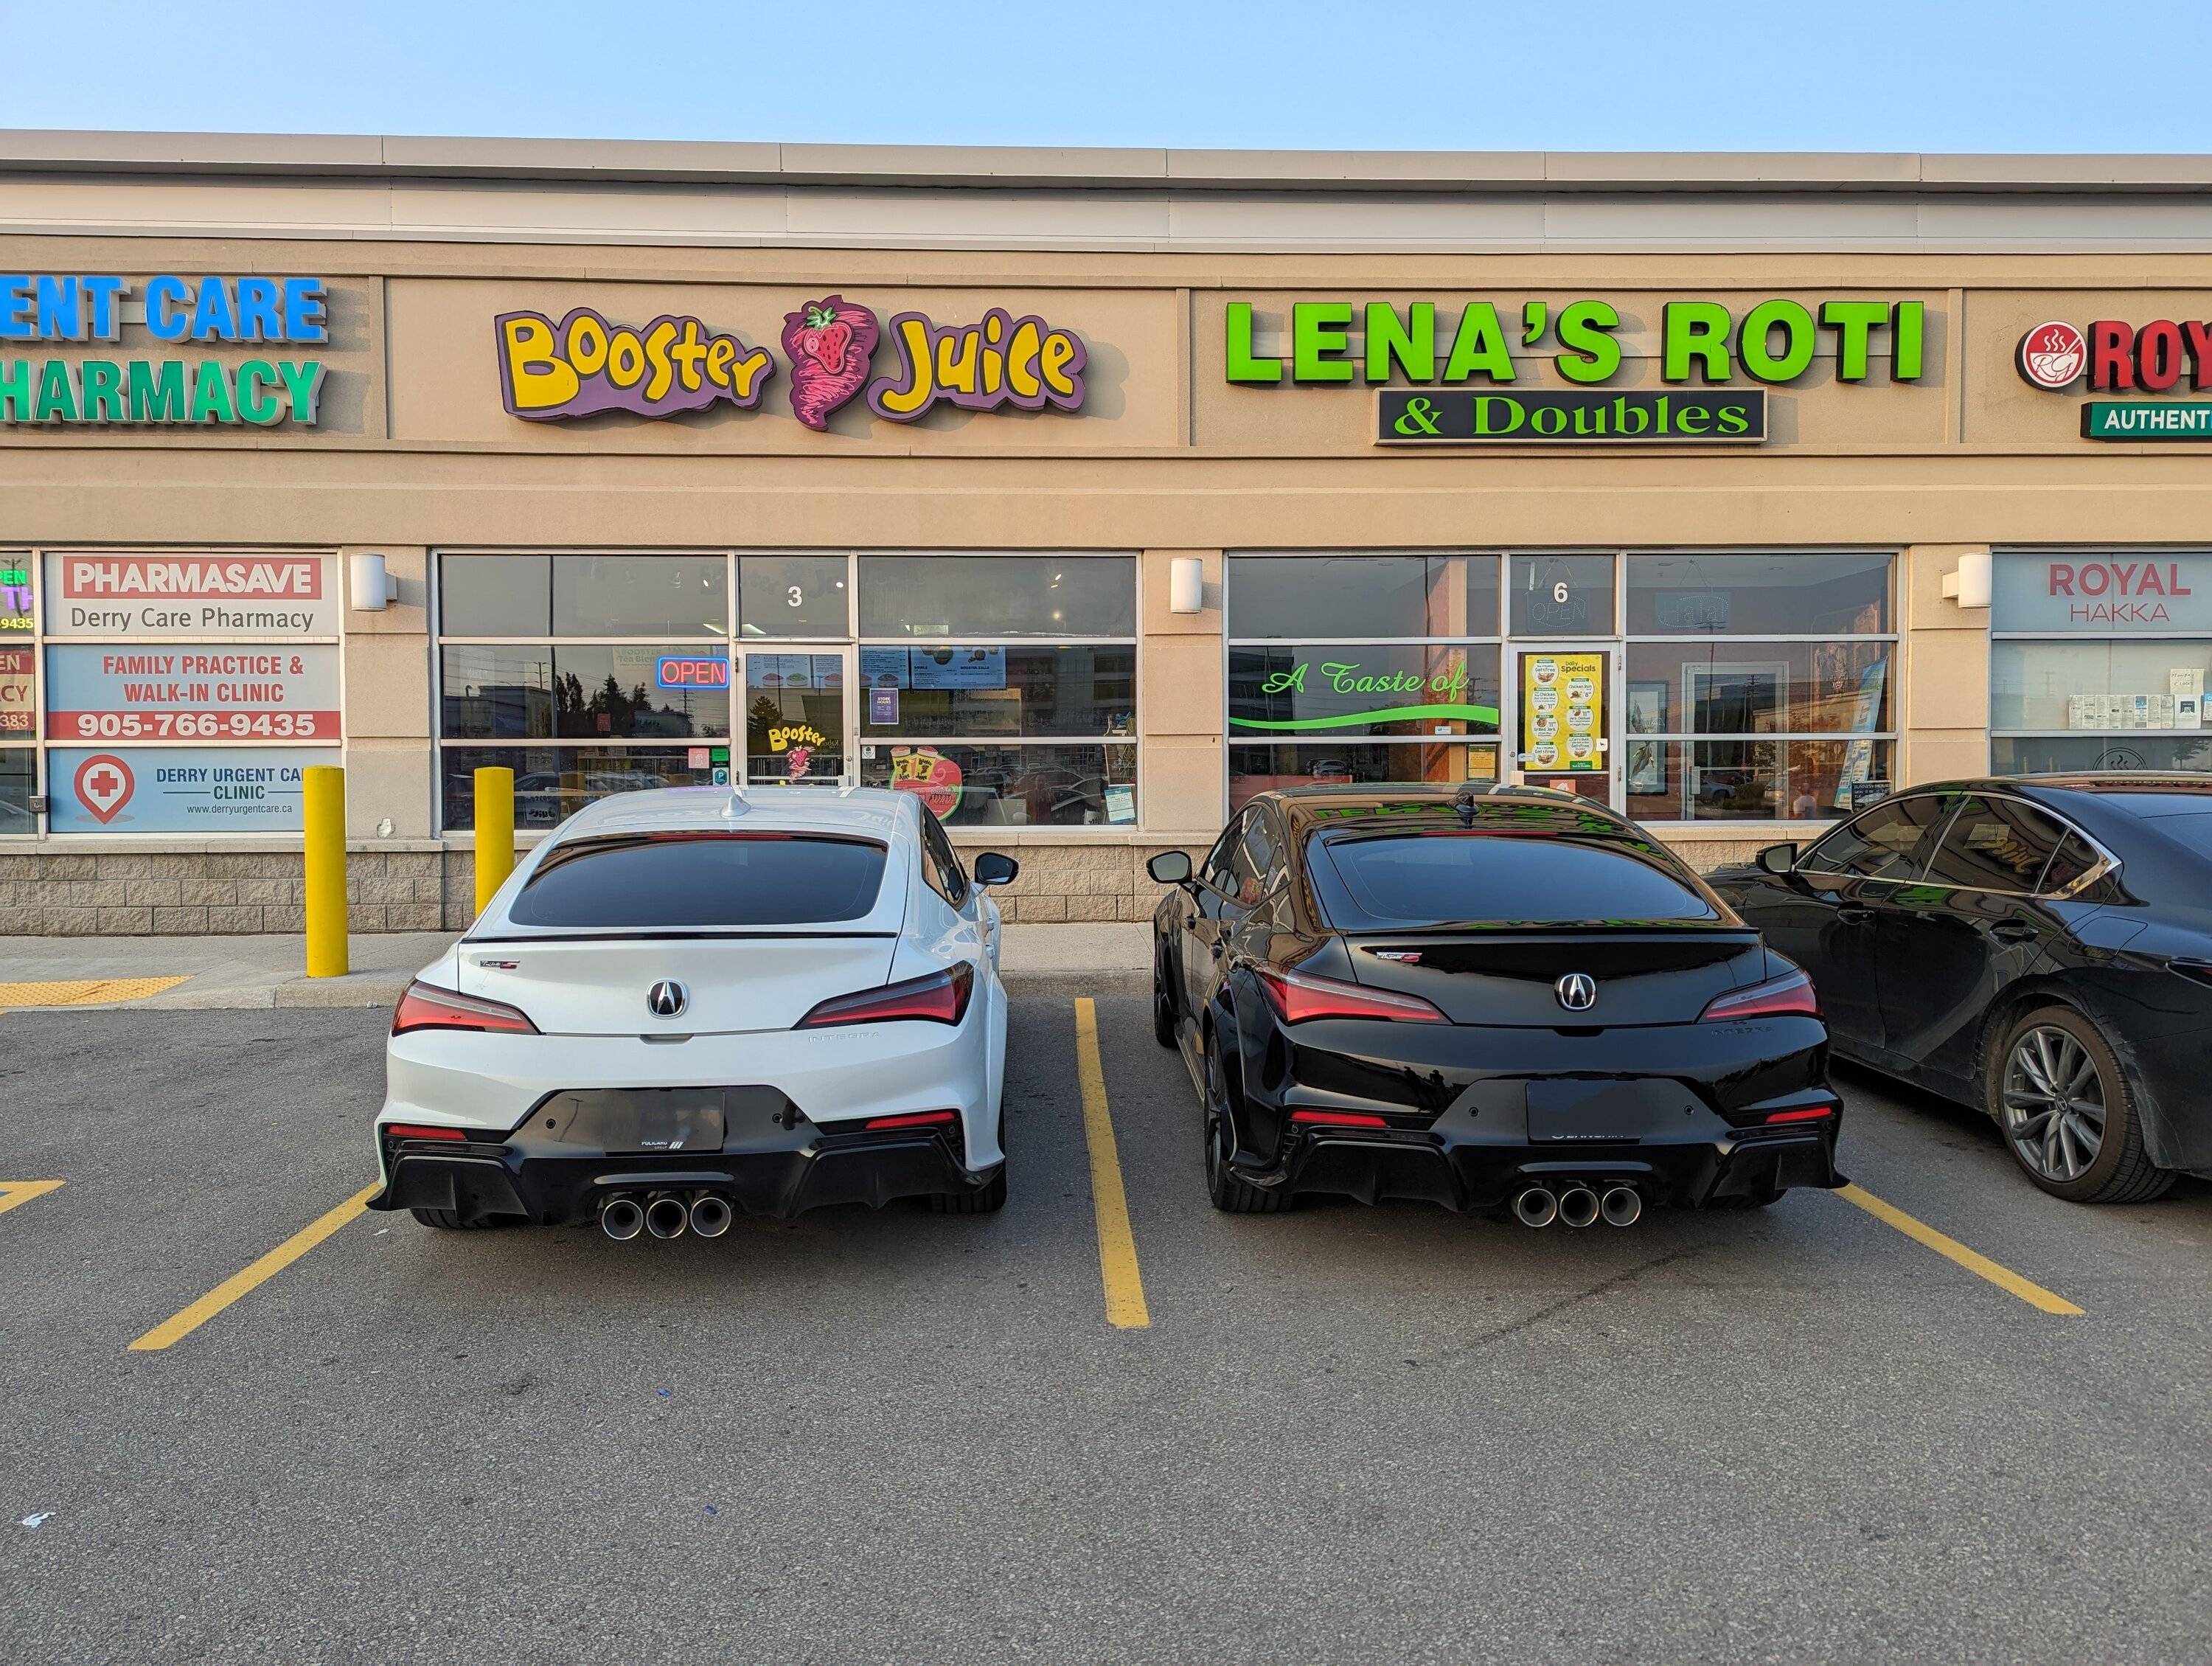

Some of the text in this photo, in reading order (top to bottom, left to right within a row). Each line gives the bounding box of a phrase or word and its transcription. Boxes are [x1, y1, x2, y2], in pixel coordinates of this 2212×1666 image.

[0, 275, 327, 341] ENT CARE
[1226, 299, 1924, 385] LENA'S ROTI
[881, 315, 1077, 413] Juice
[2091, 319, 2212, 389] ROY
[0, 359, 321, 423] HARMACY
[1394, 395, 1750, 435] & Doubles
[2104, 410, 2211, 429] AUTHENT
[73, 563, 312, 593] PHARMASAVE
[2049, 563, 2191, 596] ROYAL
[787, 586, 803, 607] 3
[1554, 583, 1568, 603] 6
[0, 618, 33, 628] 9435
[72, 607, 314, 632] Derry Care Pharmacy
[2070, 603, 2170, 622] HAKKA
[102, 656, 305, 675] FAMILY PRACTICE &
[661, 661, 726, 684] OPEN
[0, 685, 28, 702] CY
[124, 683, 285, 703] WALK-IN CLINIC
[1262, 661, 1470, 703] A Taste of
[77, 713, 316, 737] 905-766-9435
[156, 768, 208, 782] DERRY
[212, 768, 276, 782] URGENT
[213, 785, 265, 800] CLINIC
[187, 804, 293, 816] www.derryurgentcare.ca
